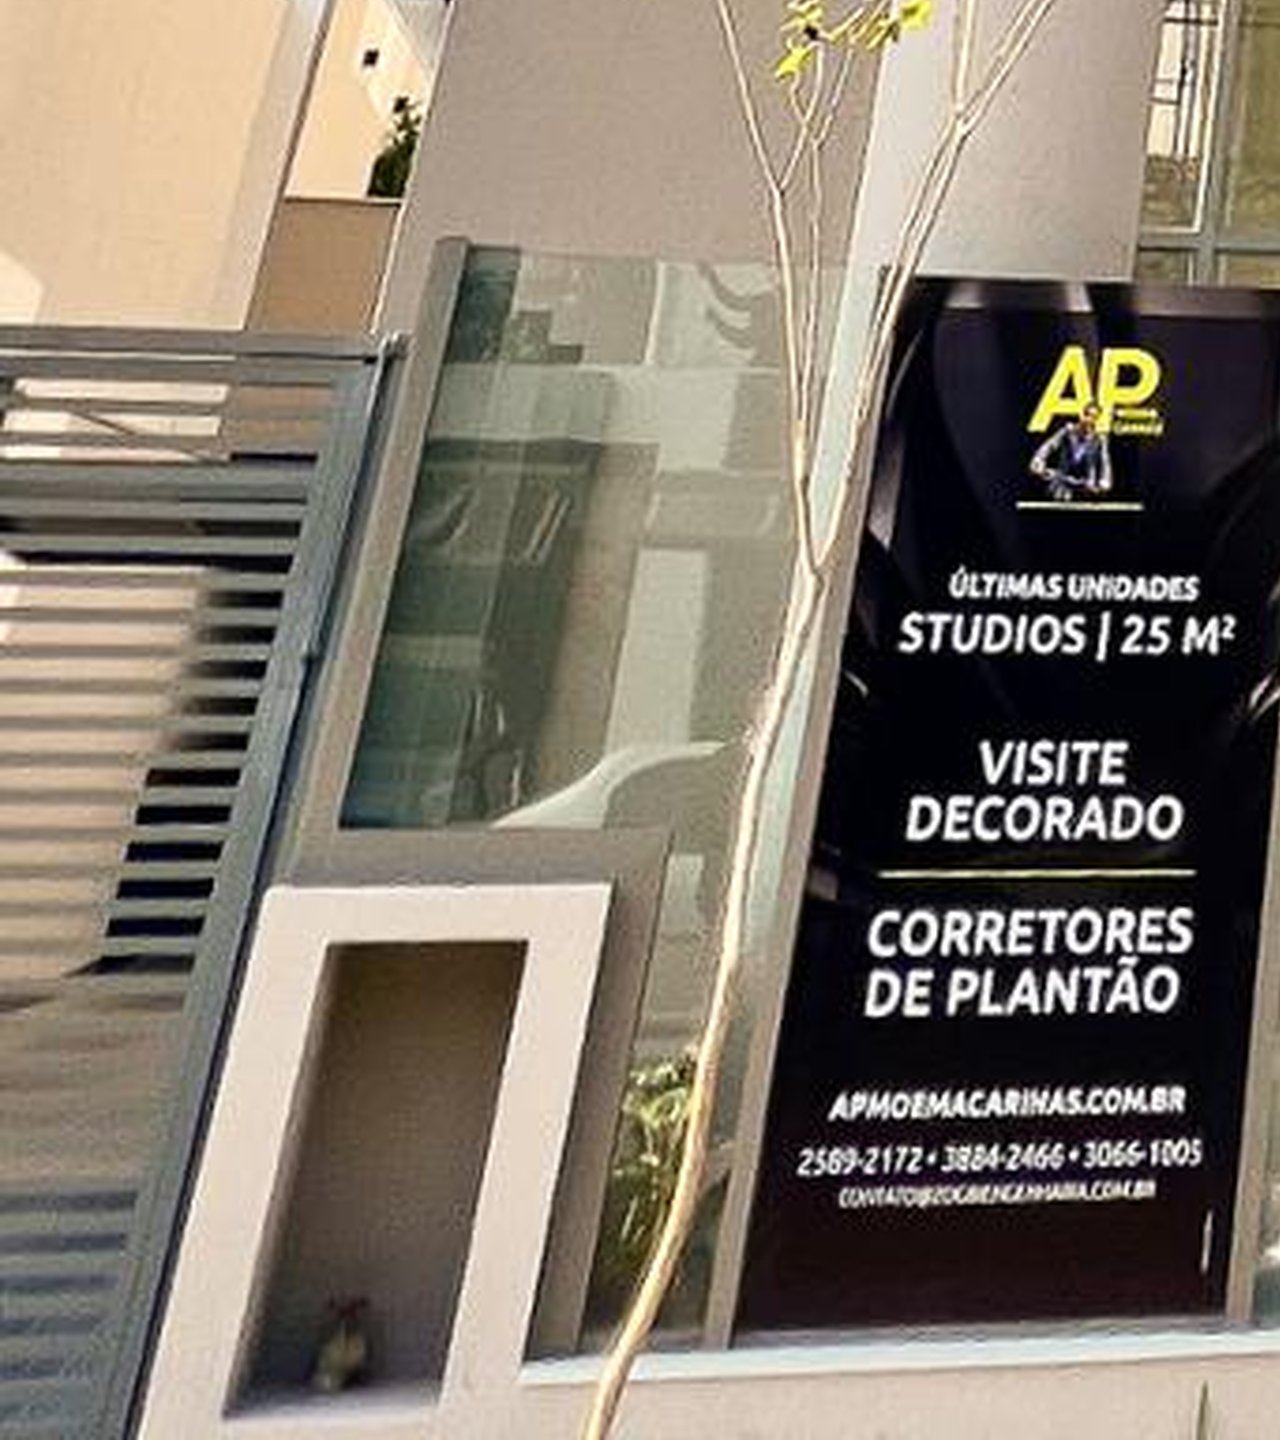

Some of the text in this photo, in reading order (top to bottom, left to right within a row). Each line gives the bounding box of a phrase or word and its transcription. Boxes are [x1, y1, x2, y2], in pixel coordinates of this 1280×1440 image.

[1026, 345, 1163, 436] AP
[949, 566, 1199, 601] ÚLTIMAS UNIDADES
[899, 612, 1085, 654] STUDIOS
[1121, 615, 1170, 654] 25
[1182, 615, 1235, 654] M²
[980, 740, 1128, 785] VISITE
[906, 795, 1183, 841] DECORADO
[868, 907, 1193, 956] CORRETORES
[865, 958, 1180, 1017] DE PLANTÃO
